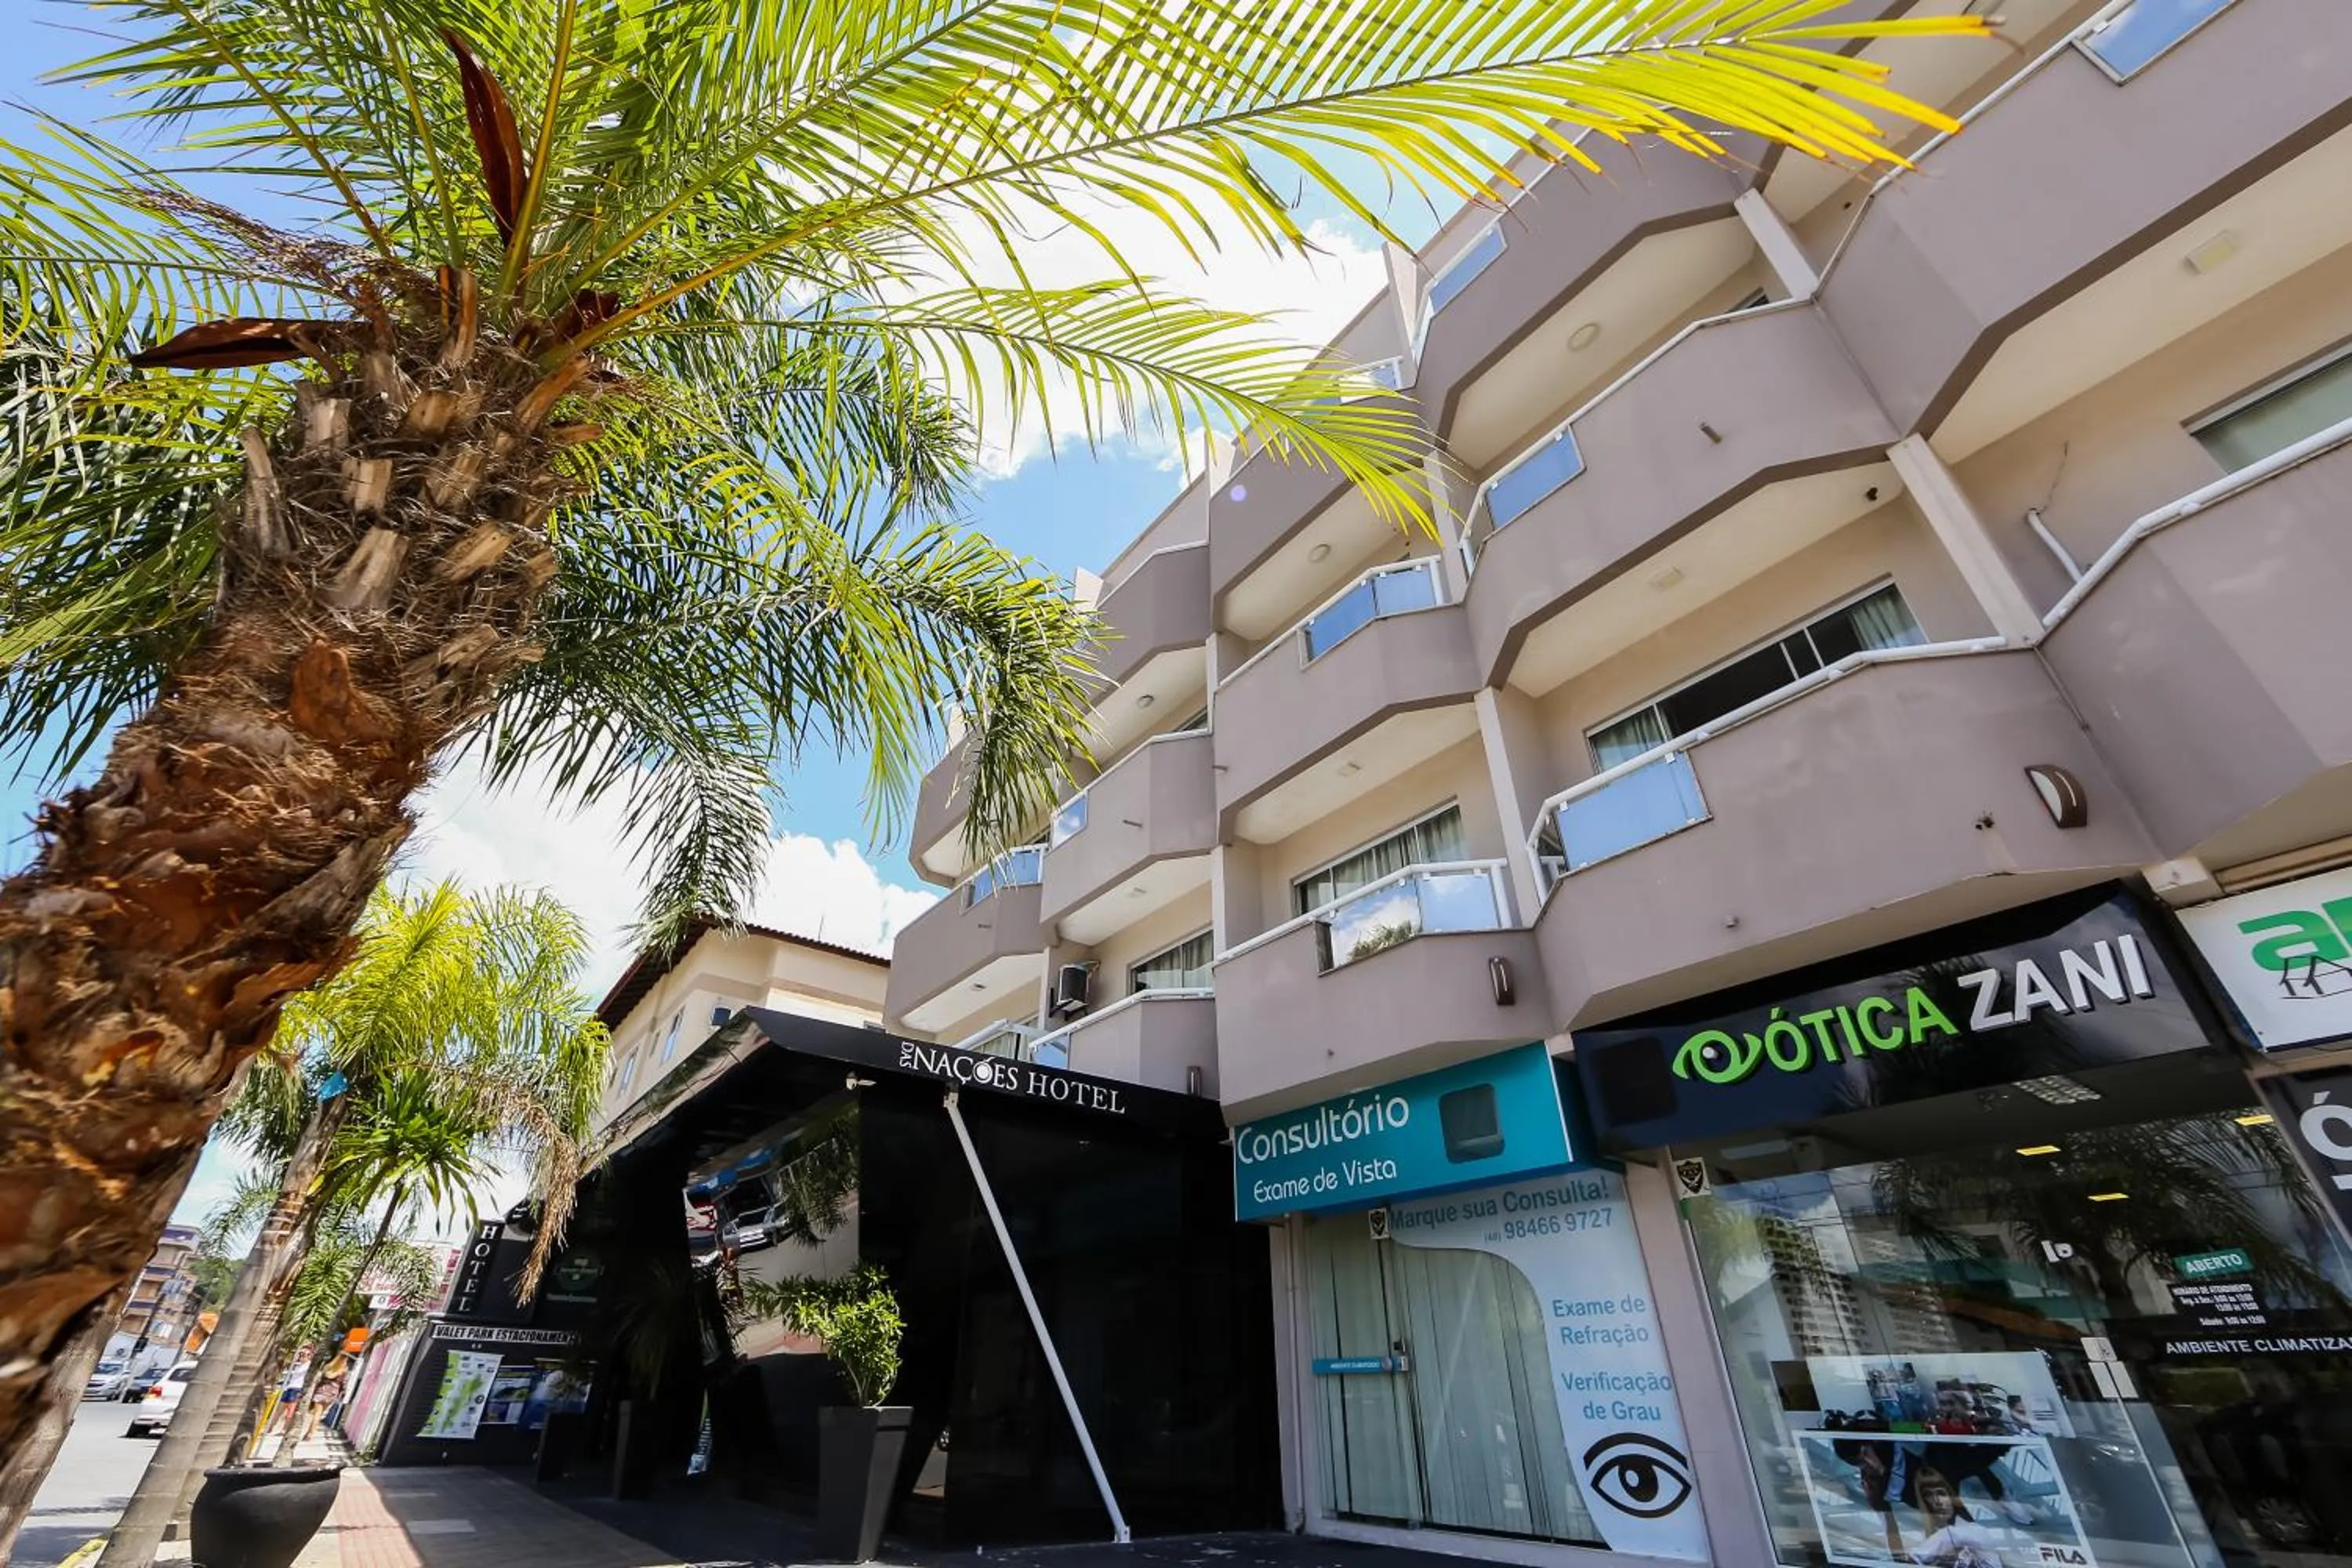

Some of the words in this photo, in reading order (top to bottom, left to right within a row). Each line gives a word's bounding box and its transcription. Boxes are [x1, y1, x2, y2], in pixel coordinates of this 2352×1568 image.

[1765, 986, 1959, 1073] ÓTICA
[1958, 934, 2154, 1031] ZANI
[899, 1041, 914, 1069] DAS
[1026, 1071, 1125, 1114] HOTEL
[1237, 1094, 1410, 1164] Consultório
[1254, 1179, 1310, 1203] Exame
[1313, 1167, 1338, 1192] de
[1342, 1158, 1397, 1186] Vista
[1388, 1204, 1457, 1231] Marque
[1462, 1199, 1497, 1220] sua
[1503, 1176, 1609, 1214] Consulta!
[1504, 1215, 1561, 1240] 98466
[1567, 1207, 1612, 1232] 9727
[458, 1225, 499, 1312] HOTEL
[2186, 1254, 2242, 1273] ABERTO
[1552, 1299, 1616, 1318] Exame
[1621, 1293, 1646, 1313] de
[468, 1327, 495, 1340] PARK
[1560, 1323, 1649, 1348] Refração
[2166, 1339, 2252, 1354] AMBIENTE
[2254, 1337, 2352, 1352] CLIMATIZA
[1561, 1371, 1672, 1396] Verificação
[1583, 1400, 1607, 1420] de
[1611, 1400, 1661, 1421] Grau
[2039, 1547, 2088, 1565] FILA
